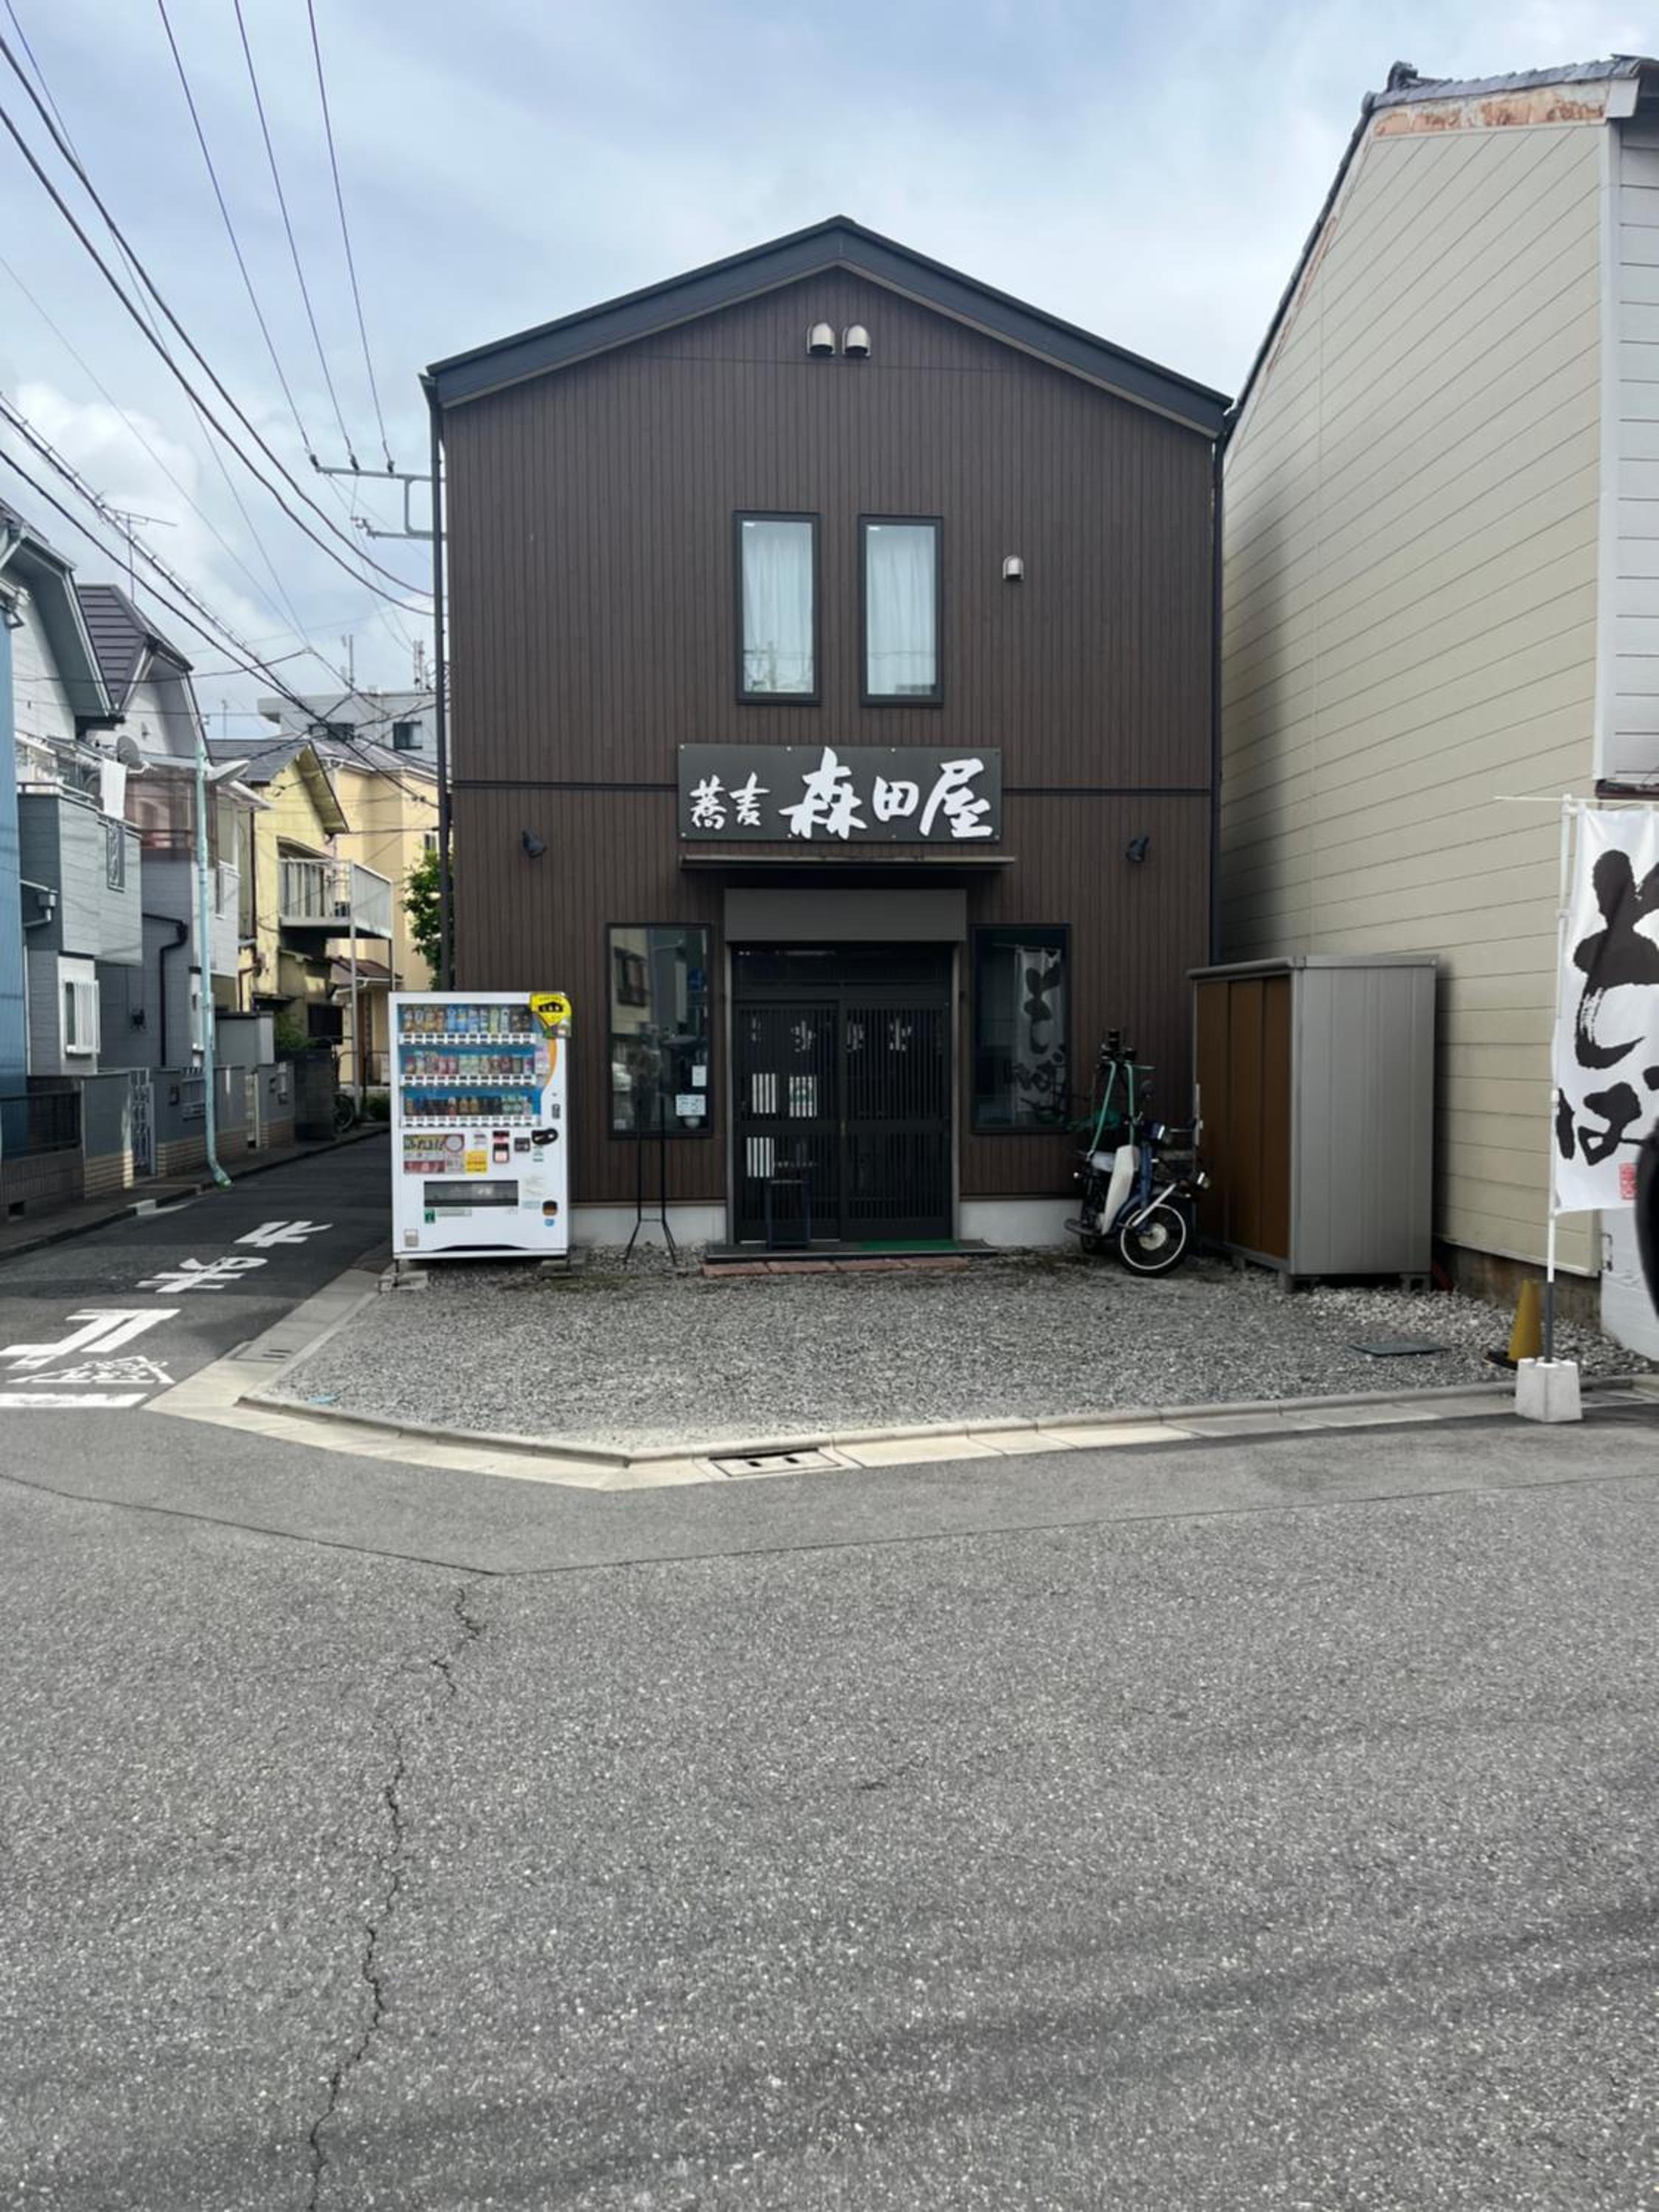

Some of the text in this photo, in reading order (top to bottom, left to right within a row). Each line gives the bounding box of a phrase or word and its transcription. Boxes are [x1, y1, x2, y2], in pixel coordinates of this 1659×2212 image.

[689, 746, 992, 840] 蕎麦 森田屋
